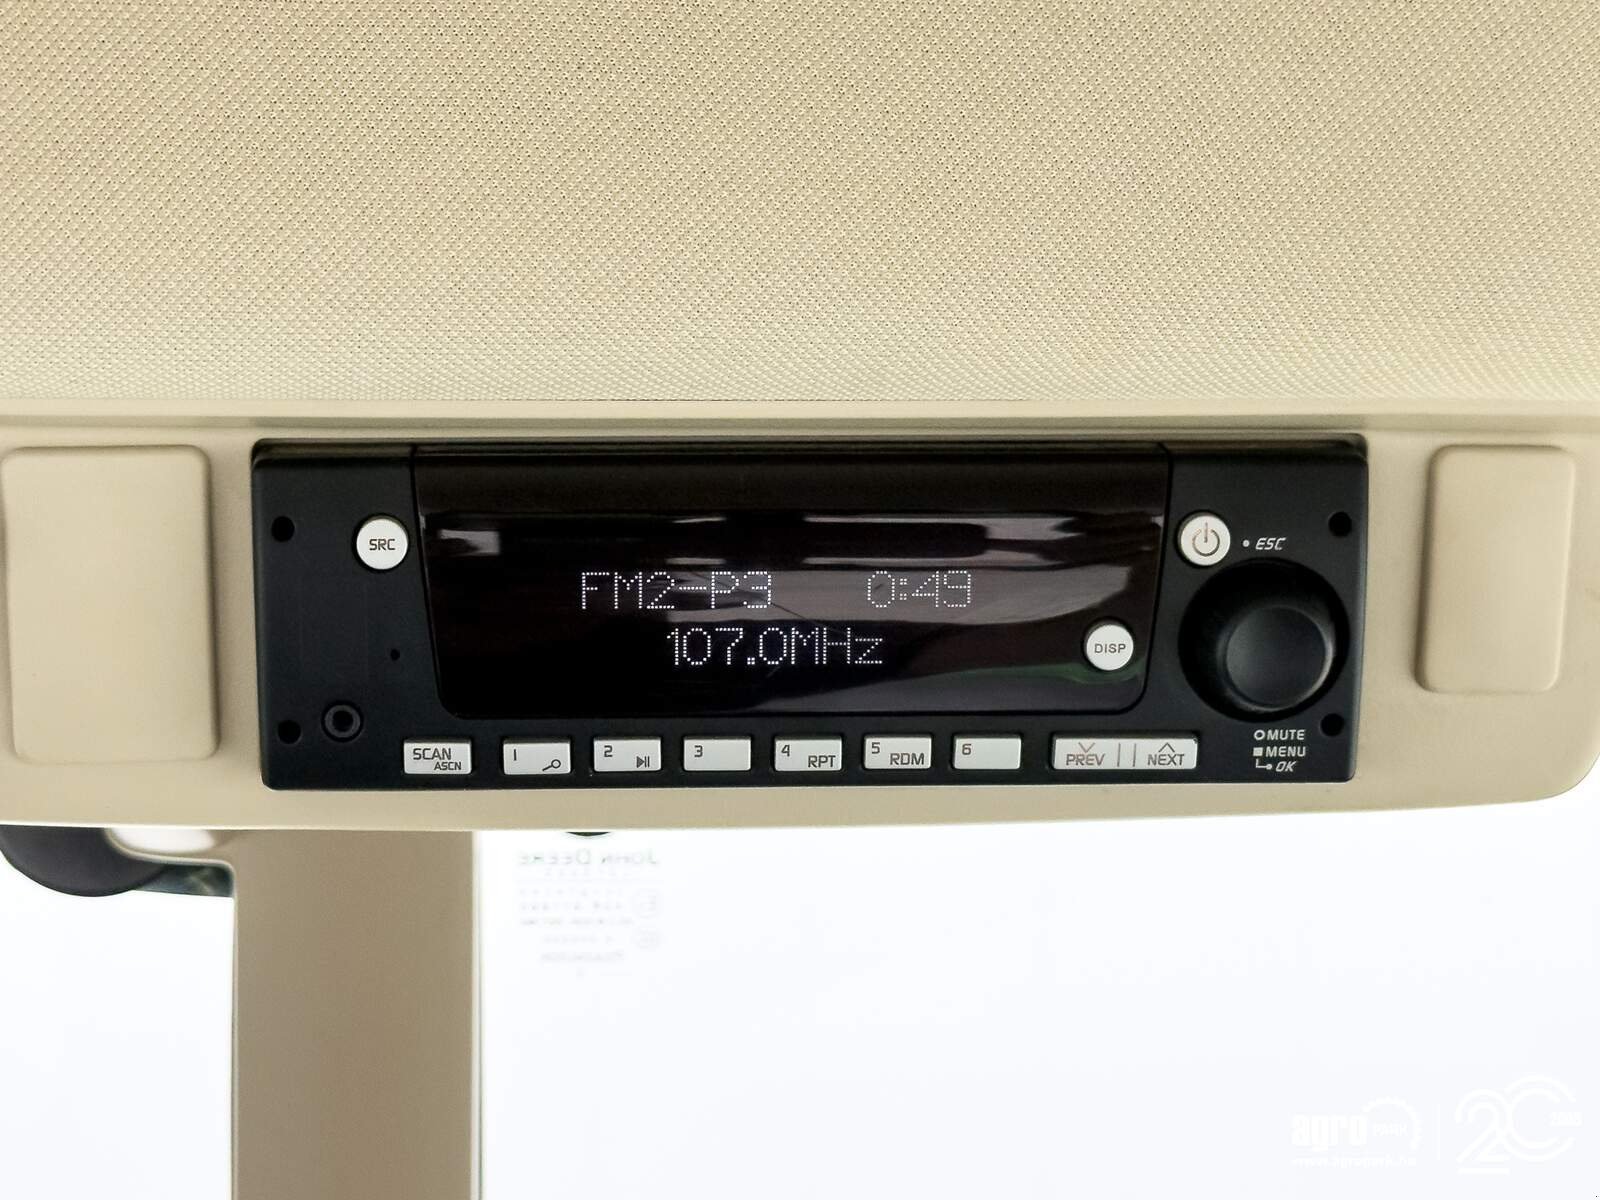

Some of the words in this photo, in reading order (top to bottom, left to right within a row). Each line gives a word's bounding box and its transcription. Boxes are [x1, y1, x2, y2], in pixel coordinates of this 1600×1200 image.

[369, 538, 396, 551] SRC
[1255, 537, 1287, 551] ESC
[581, 571, 772, 609] FM2-P3
[866, 570, 972, 608] 0:49
[665, 626, 884, 665] 107.0MHz
[1094, 643, 1126, 654] DISP
[1267, 729, 1305, 740] MUTE
[412, 747, 451, 761] SCAN
[603, 745, 613, 758] 2
[694, 745, 703, 758] 3
[781, 743, 791, 757] 4
[871, 742, 881, 755] 5
[962, 743, 972, 756] 6
[1265, 746, 1306, 757] MENU
[808, 754, 836, 768] RPT
[890, 752, 925, 766] RDM
[1066, 753, 1106, 766] PREV
[1148, 753, 1185, 766] NEXT
[434, 761, 462, 771] ASCN
[1275, 761, 1297, 772] OK
